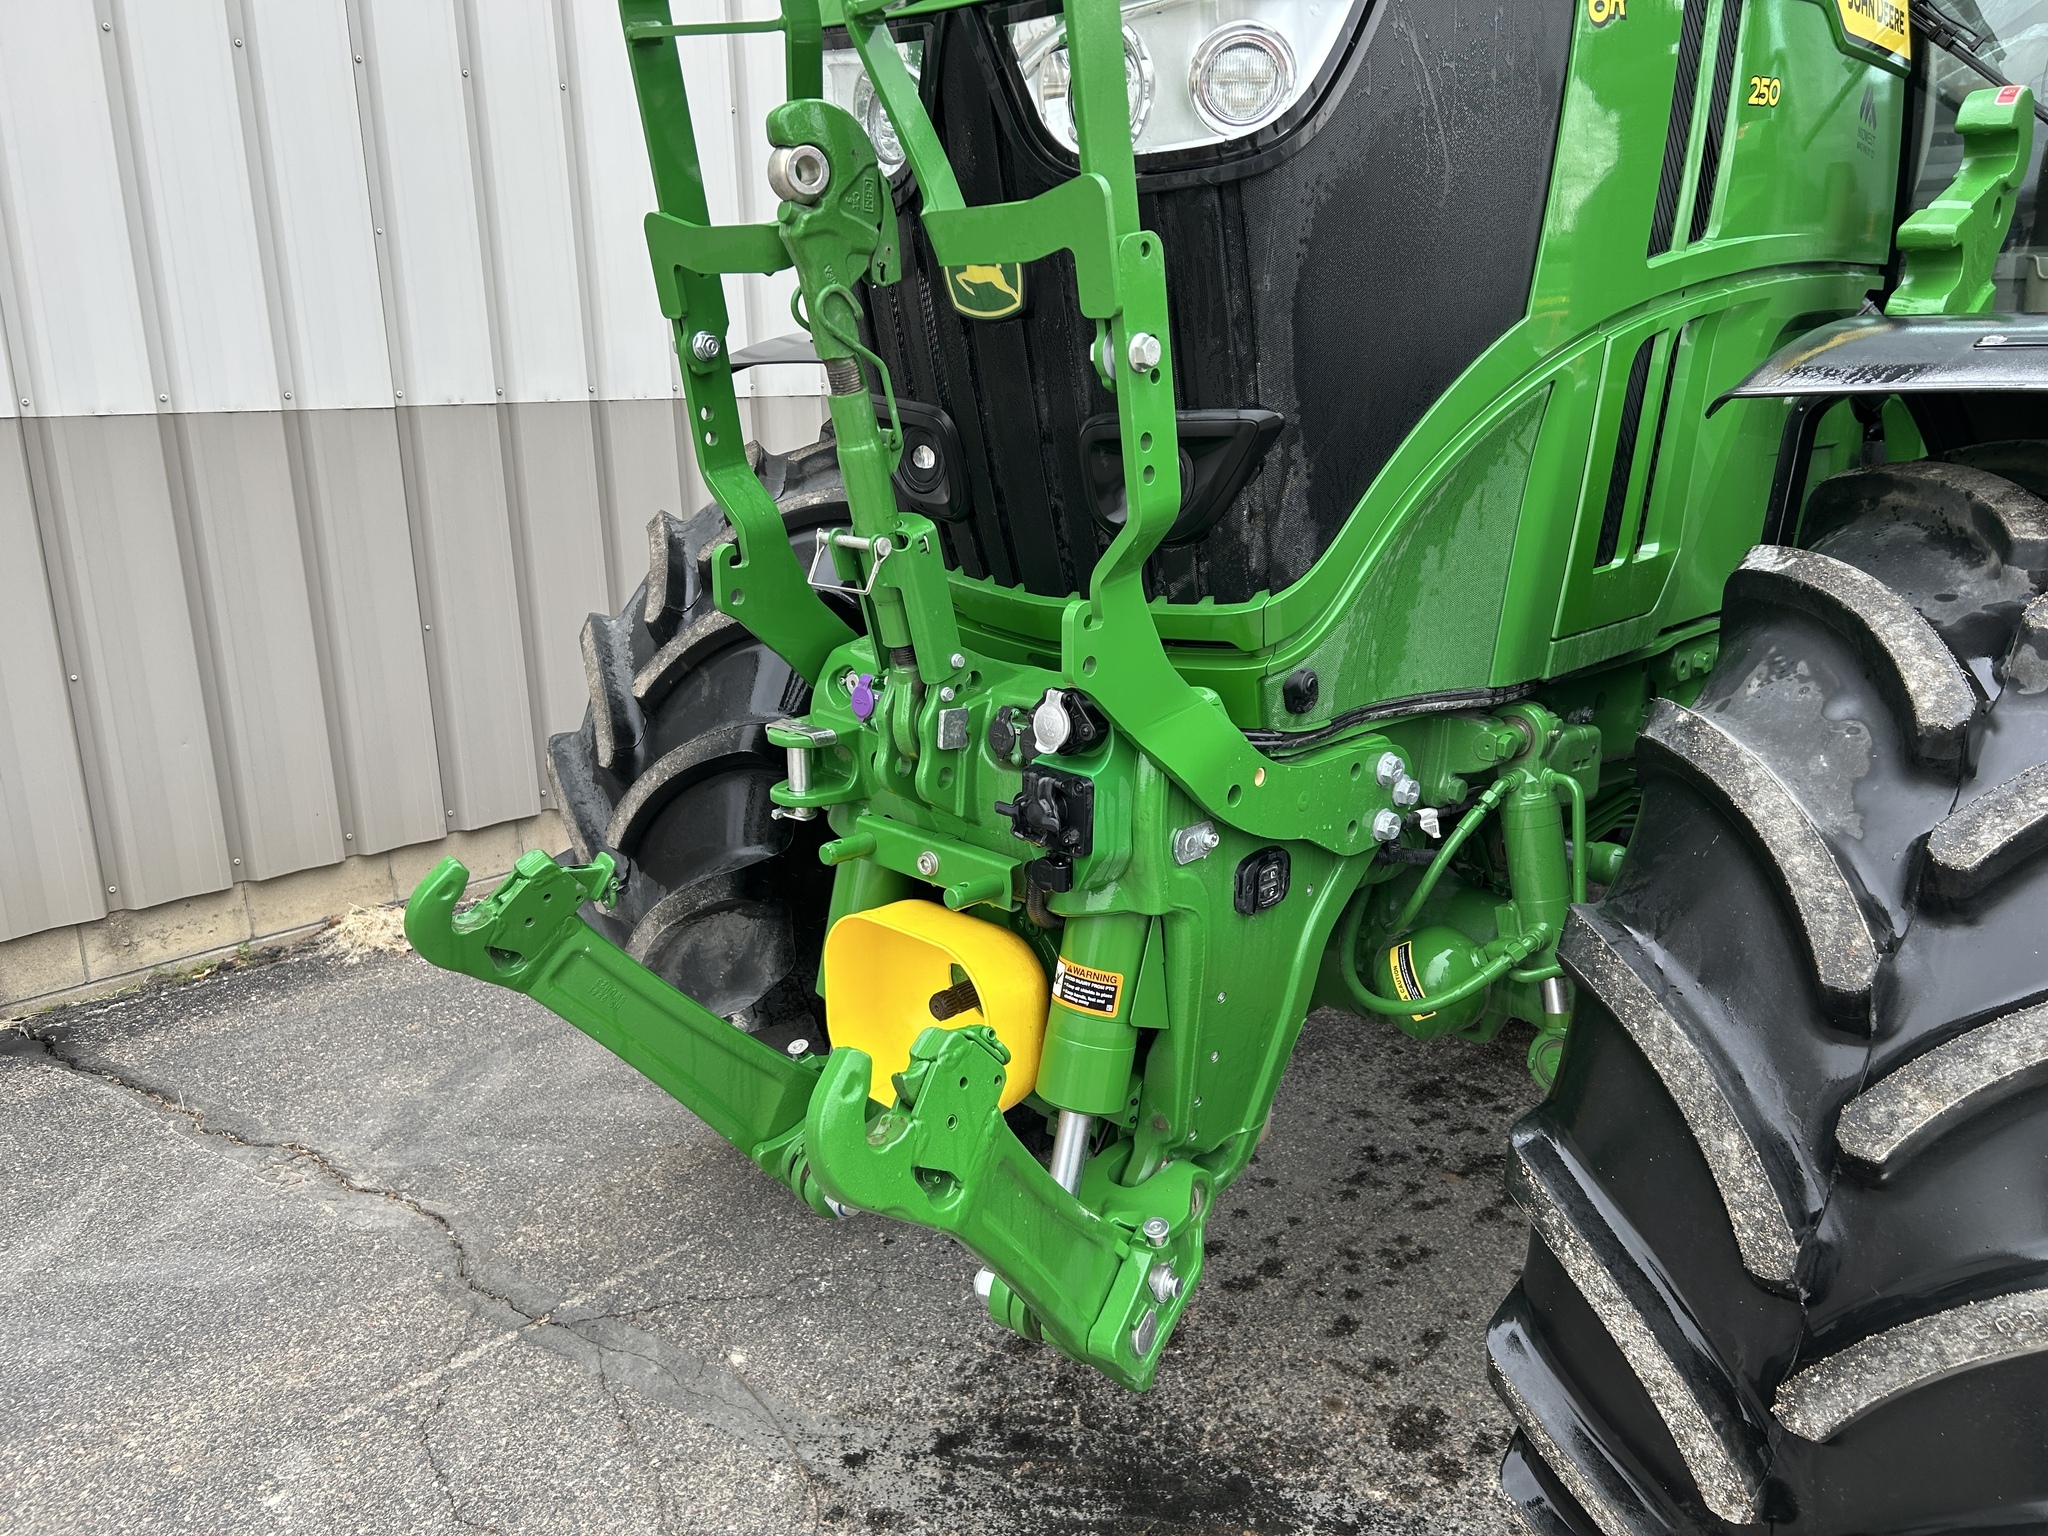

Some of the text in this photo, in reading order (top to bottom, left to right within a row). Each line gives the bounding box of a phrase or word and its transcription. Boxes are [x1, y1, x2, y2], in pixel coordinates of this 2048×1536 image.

[1876, 0, 1905, 35] DEERE
[1747, 75, 1781, 107] 250
[1073, 965, 1117, 984] WARNING
[1393, 965, 1405, 993] CAUTION
